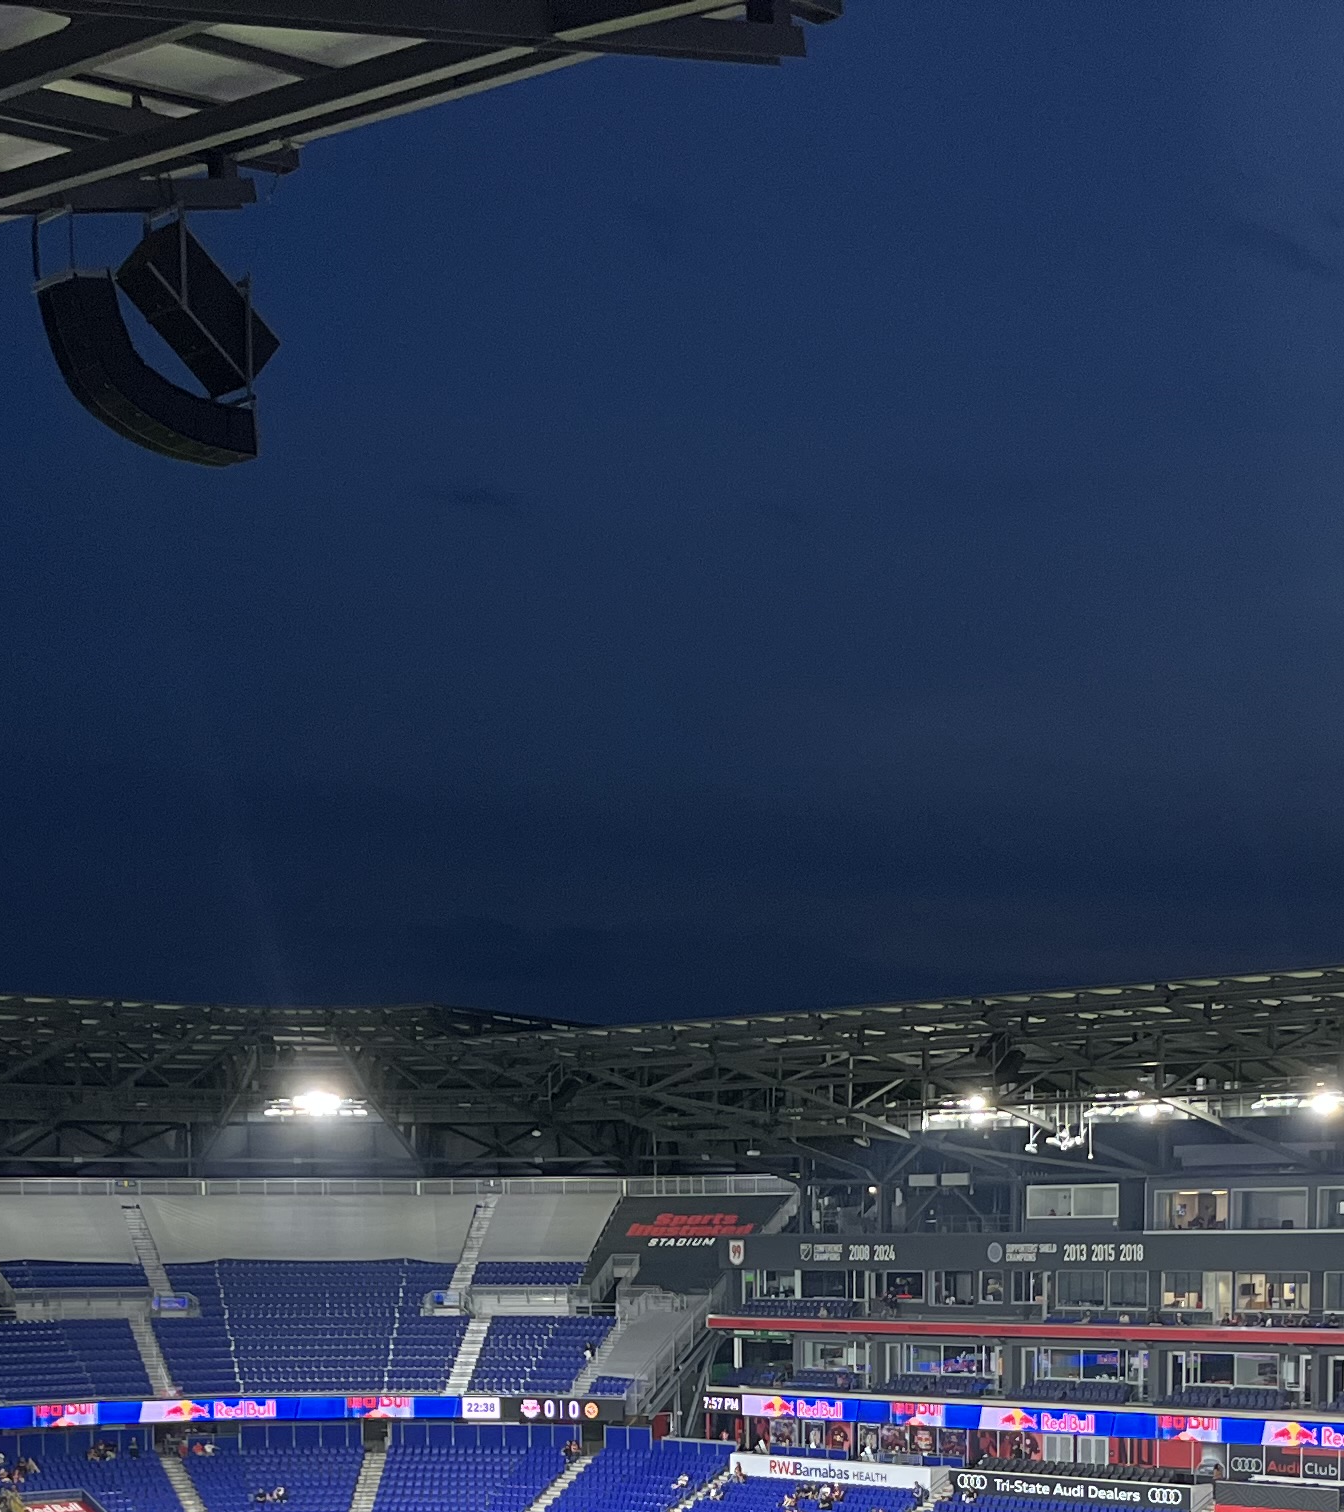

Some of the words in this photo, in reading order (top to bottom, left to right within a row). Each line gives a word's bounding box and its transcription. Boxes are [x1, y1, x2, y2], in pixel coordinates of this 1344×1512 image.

[654, 1213, 739, 1227] Sports
[626, 1223, 754, 1236] Illustrated
[647, 1237, 716, 1247] STADIUM
[732, 1244, 742, 1258] 99
[874, 1245, 895, 1261] 2024
[1064, 1244, 1087, 1261] 2013
[1091, 1244, 1115, 1261] 2015
[1119, 1244, 1144, 1261] 2018
[214, 1401, 244, 1418] Red
[245, 1400, 276, 1418] Bull
[467, 1402, 496, 1413] 22:38
[703, 1396, 724, 1410] 7:57
[725, 1398, 739, 1411] PM
[797, 1400, 819, 1418] Red
[820, 1402, 843, 1419] Bull
[1041, 1413, 1067, 1431] Red
[1068, 1414, 1095, 1433] Bull
[1267, 1460, 1300, 1474] Audi
[1305, 1462, 1338, 1477] Club
[852, 1470, 887, 1483] HEALTH
[994, 1478, 1050, 1496] Tri-State
[1053, 1483, 1084, 1498] Audi
[1088, 1486, 1140, 1502] Dealers
